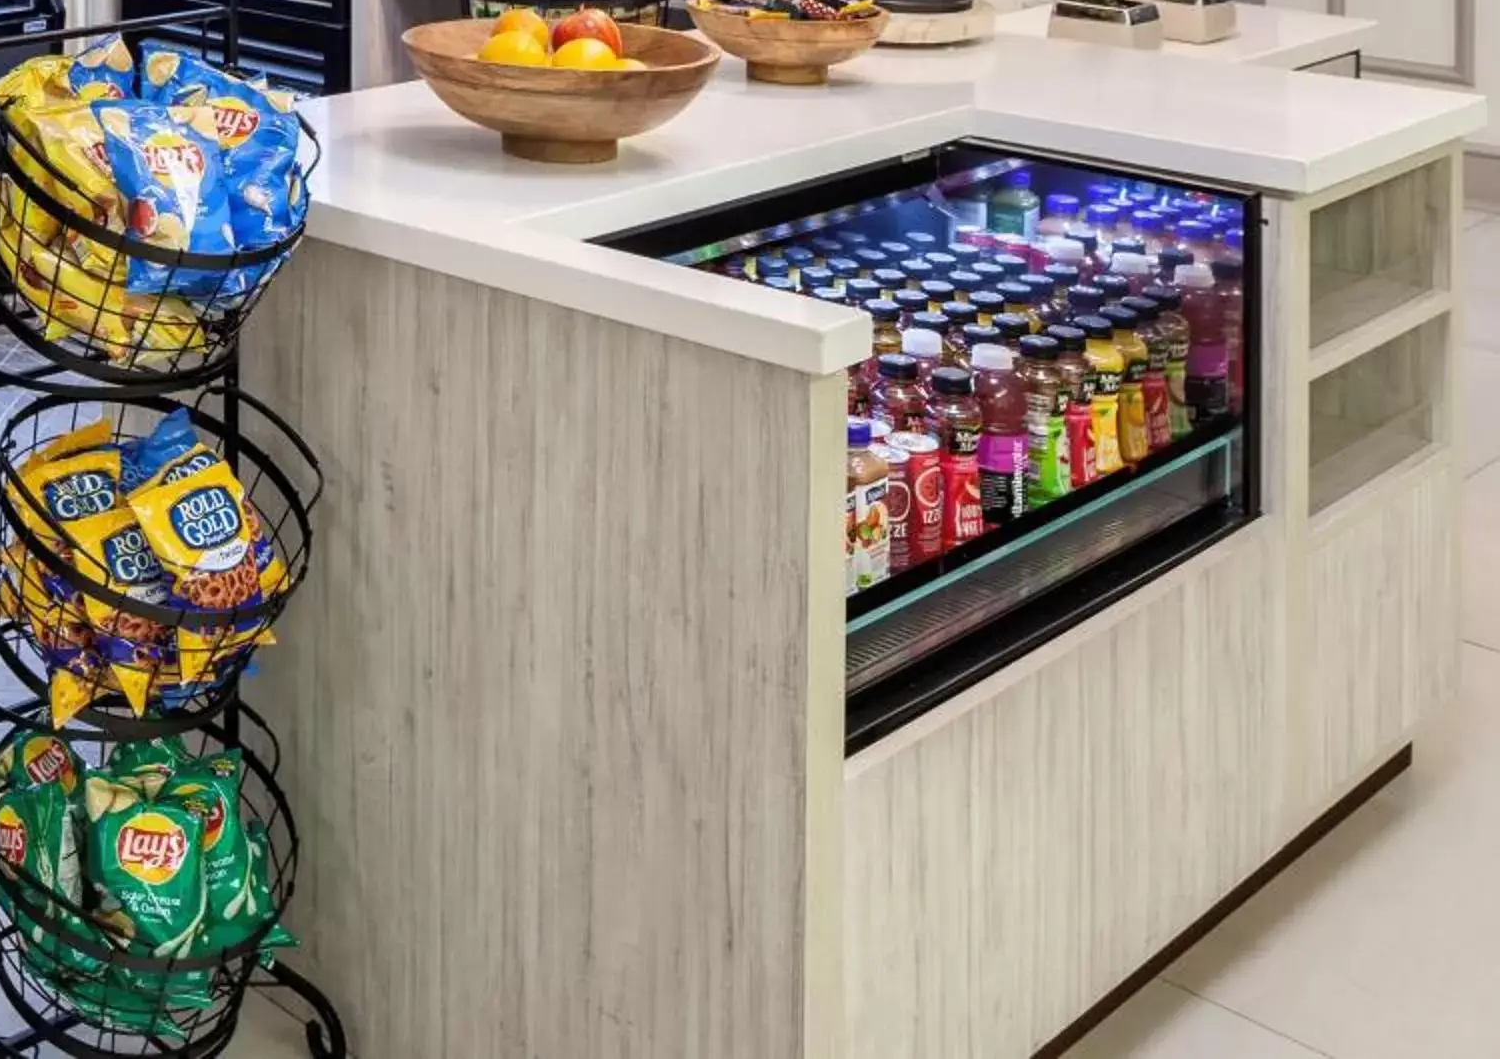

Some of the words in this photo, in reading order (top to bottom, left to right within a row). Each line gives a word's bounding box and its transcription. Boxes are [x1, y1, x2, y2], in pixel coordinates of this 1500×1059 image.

[177, 488, 225, 521] ROLD
[183, 508, 238, 546] GOLD
[120, 828, 184, 870] Lay's
